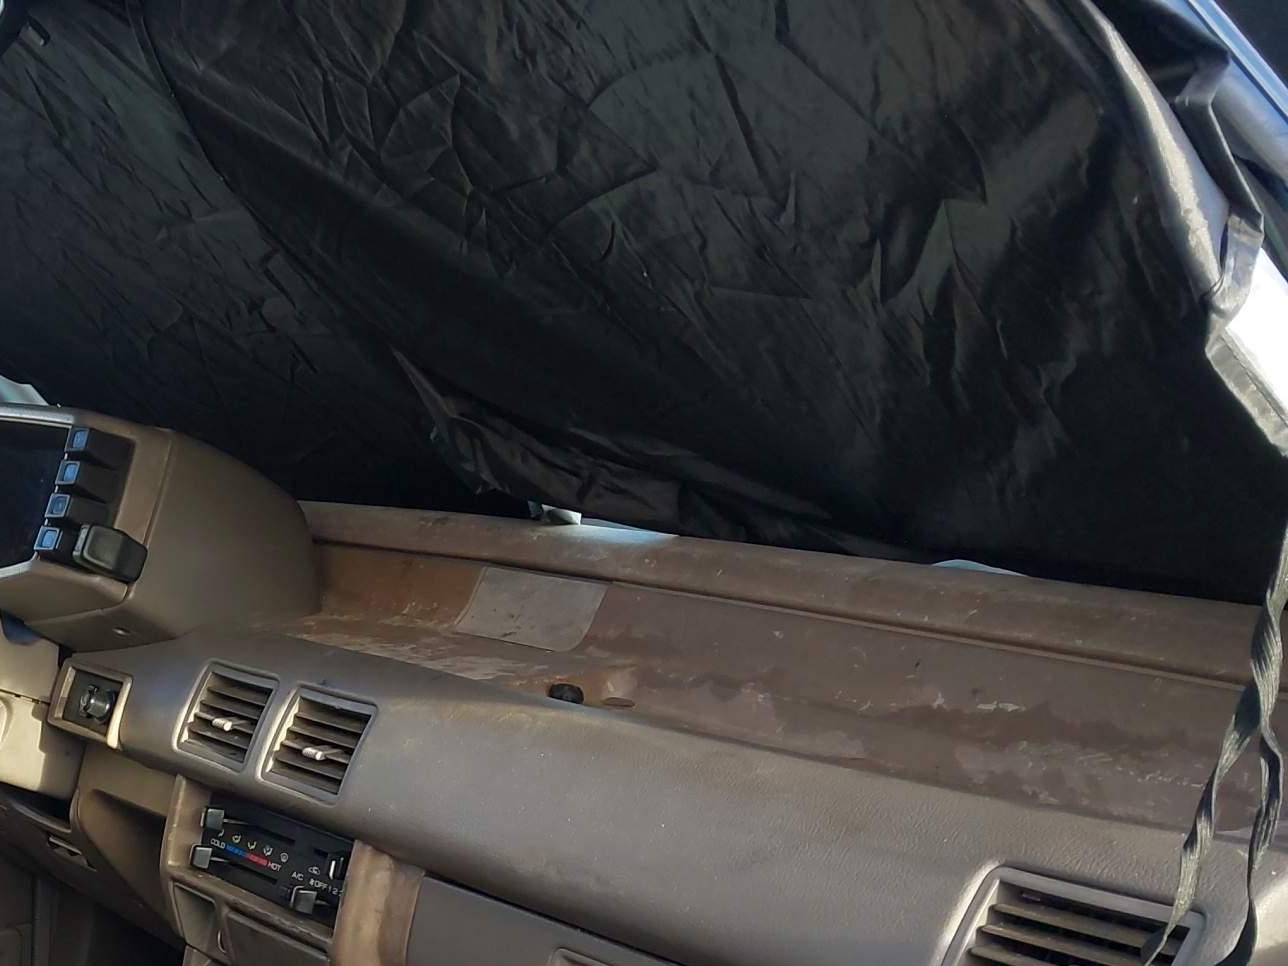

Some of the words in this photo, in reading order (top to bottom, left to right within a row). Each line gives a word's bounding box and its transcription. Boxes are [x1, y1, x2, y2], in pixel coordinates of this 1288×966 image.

[210, 838, 226, 848] COLD
[267, 861, 282, 872] HOT
[292, 872, 304, 880] A/C
[315, 878, 328, 890] OFF
